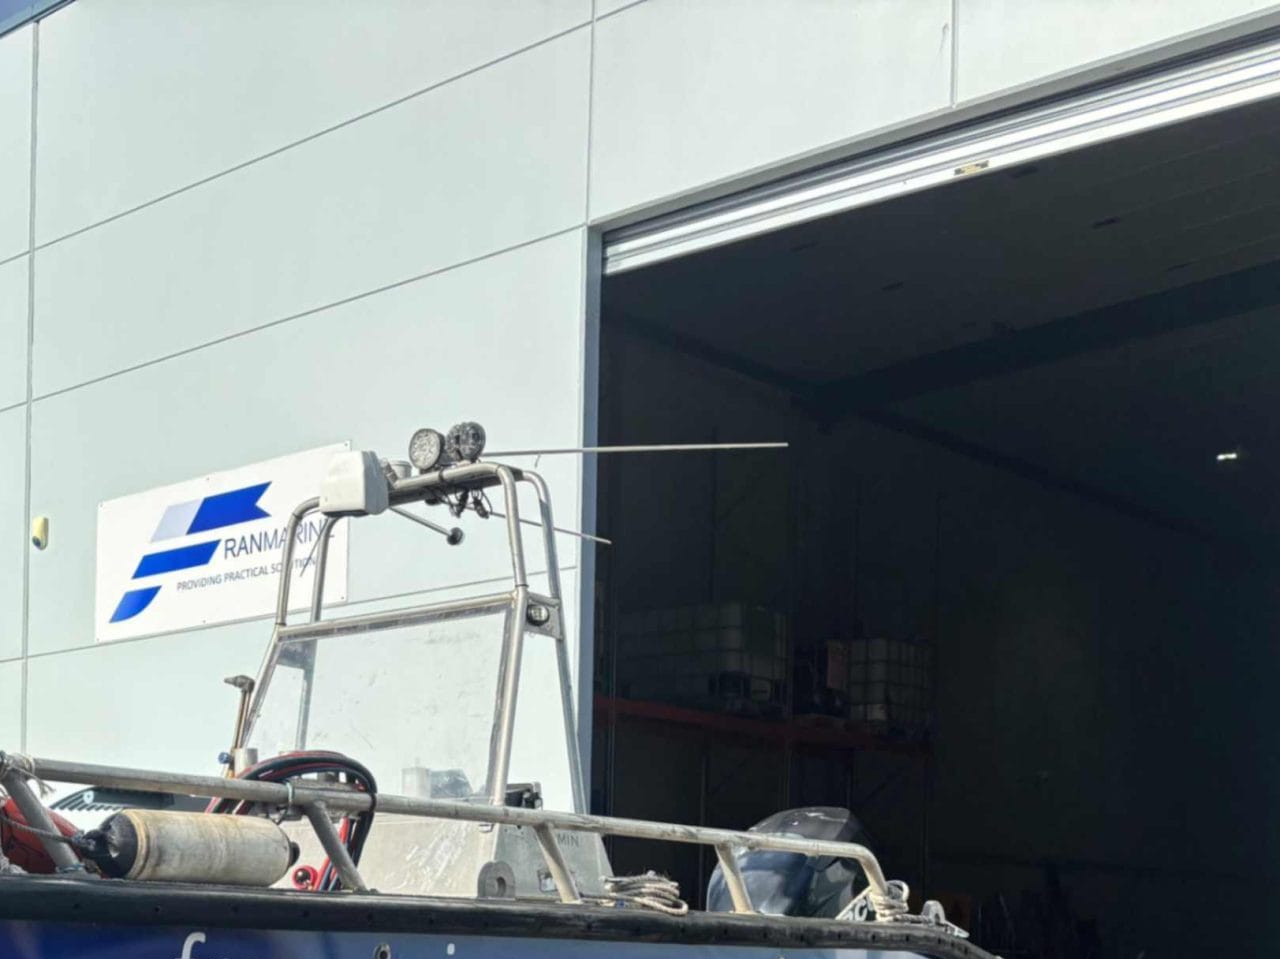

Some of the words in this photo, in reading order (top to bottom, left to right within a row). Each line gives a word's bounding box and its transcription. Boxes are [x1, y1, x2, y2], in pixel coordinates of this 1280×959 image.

[224, 518, 335, 560] RANMARIN
[176, 573, 222, 591] PROVIDING
[223, 562, 269, 582] PRACTICAL
